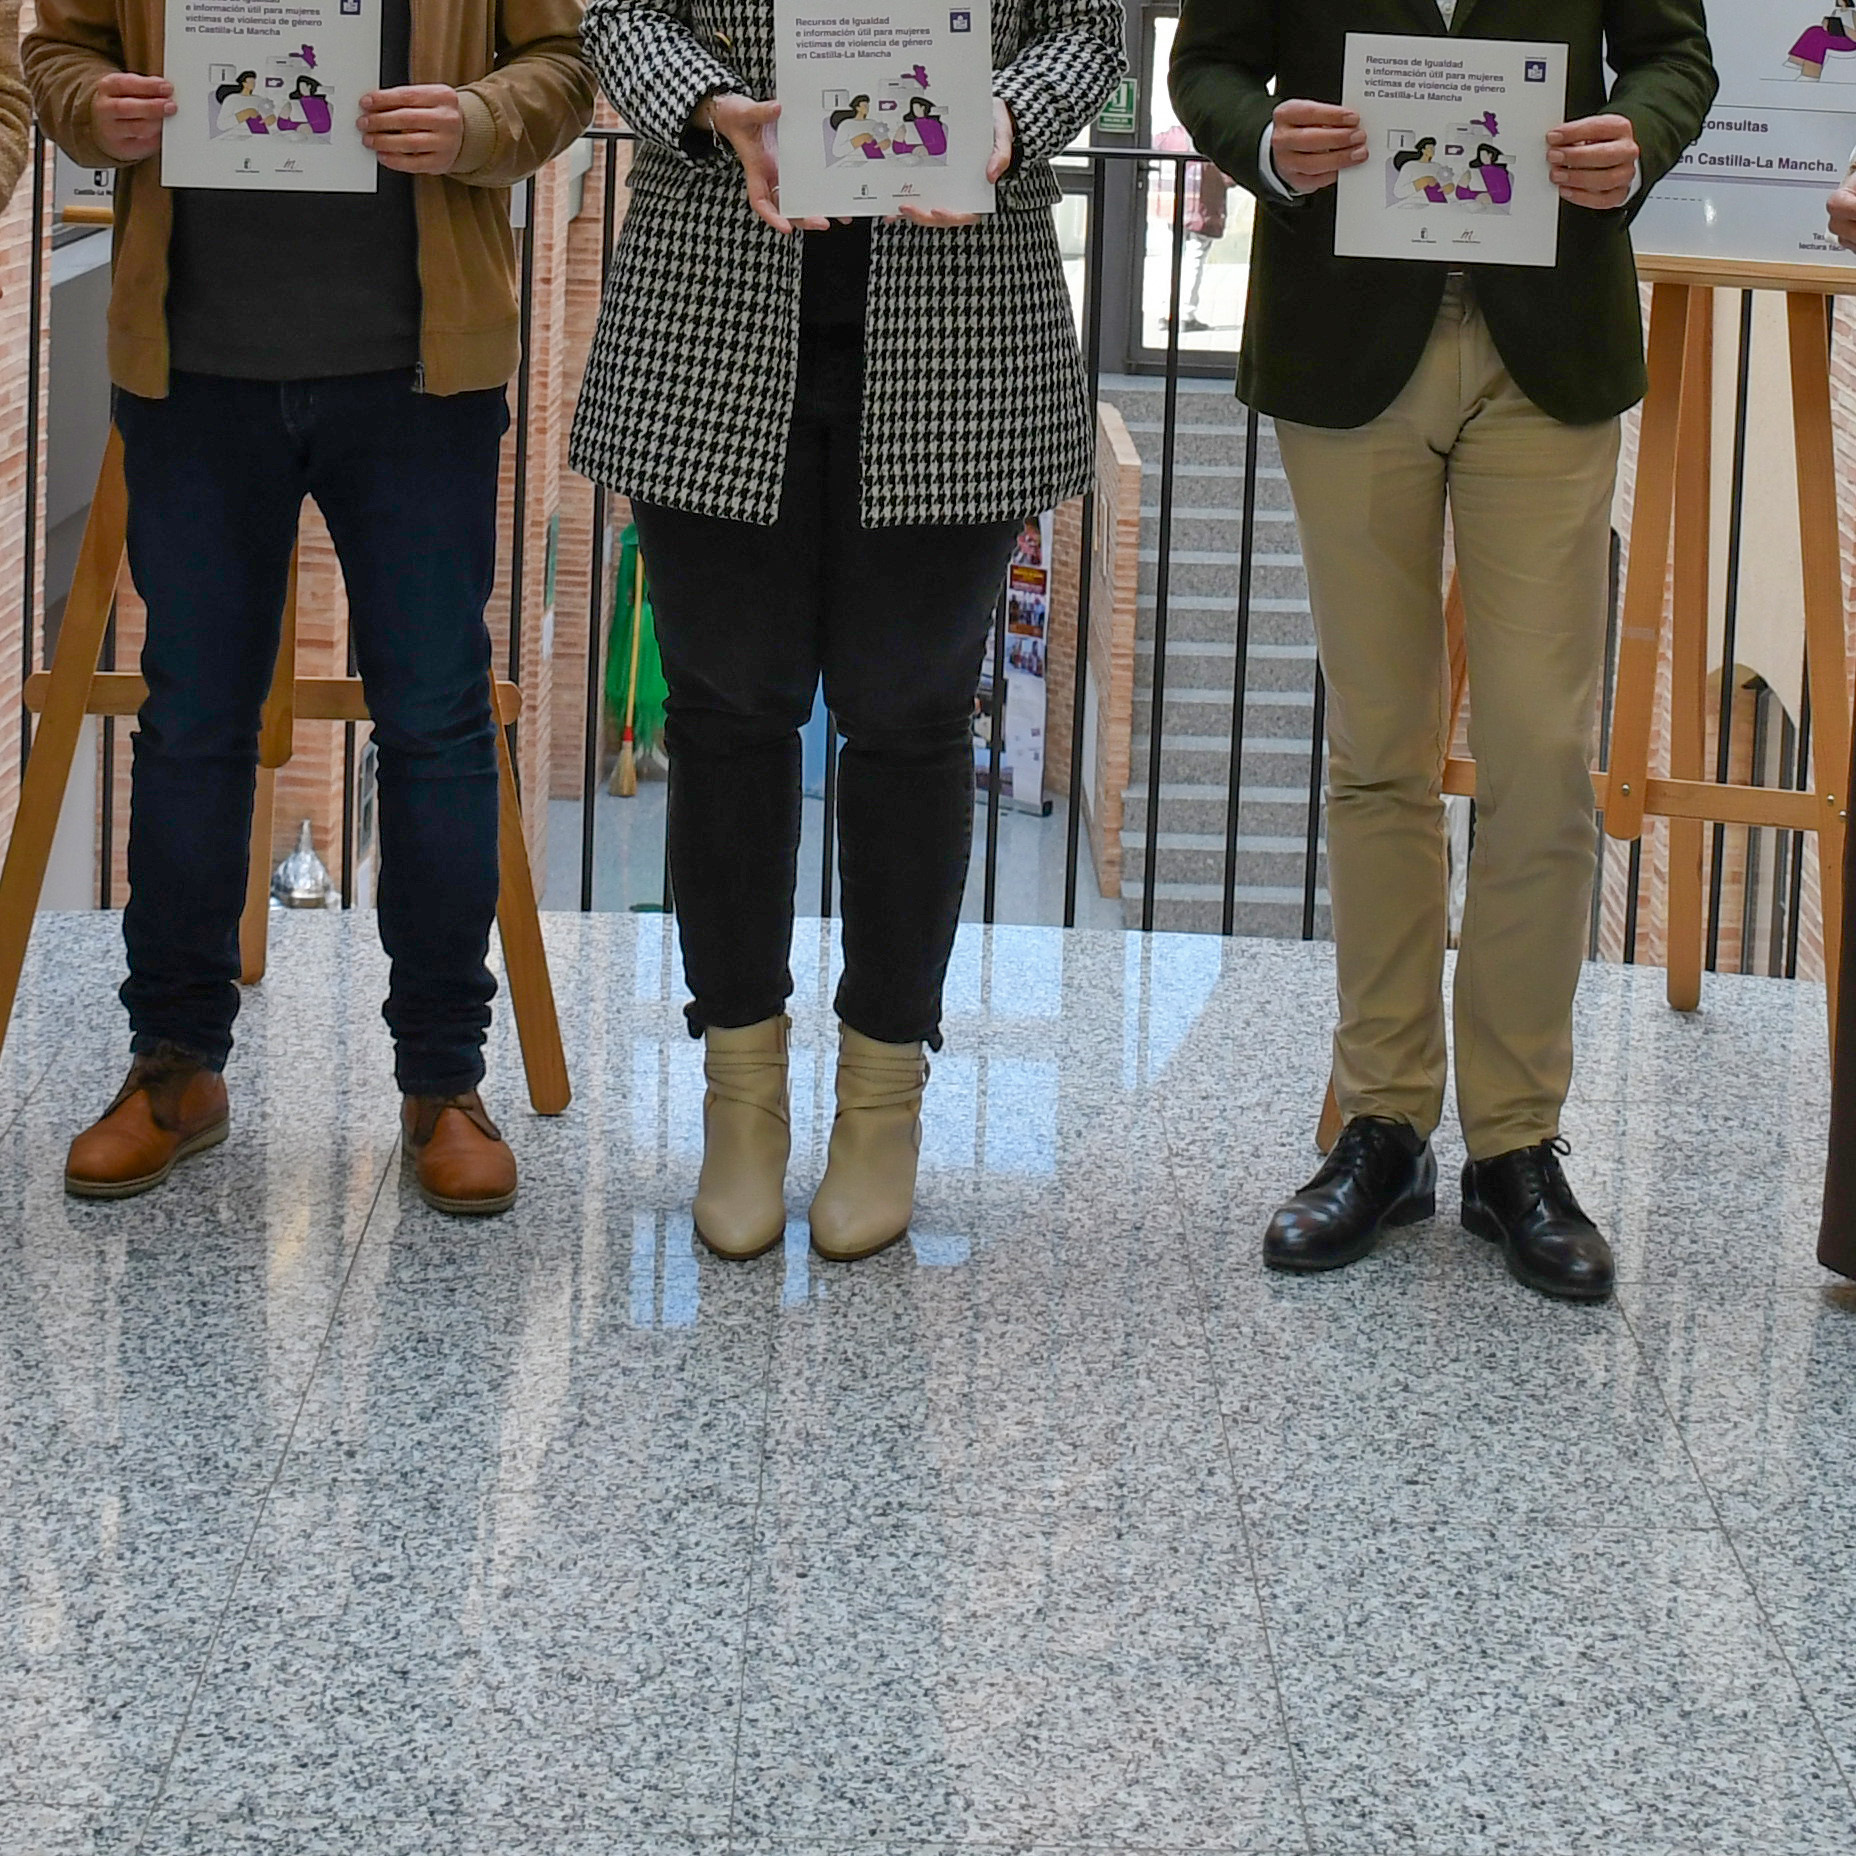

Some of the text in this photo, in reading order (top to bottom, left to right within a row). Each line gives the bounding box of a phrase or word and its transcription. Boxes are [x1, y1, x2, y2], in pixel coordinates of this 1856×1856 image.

[795, 16, 890, 27] Recursos de Igualdad
[803, 28, 856, 38] información
[857, 27, 872, 36] útil
[873, 29, 893, 38] para
[895, 28, 931, 37] mujeres
[795, 38, 933, 49] víctimas de violencia de género
[809, 50, 856, 60] Castilla-La
[857, 50, 892, 58] Mancha
[1366, 55, 1464, 69] Recursos de Igualdad
[1372, 67, 1427, 78] información
[1428, 70, 1444, 79] útil
[1445, 72, 1466, 81] para
[1467, 73, 1504, 83] mujeres
[1364, 78, 1506, 94] víctimas de violencia de género
[1363, 89, 1463, 102] en Castilla-La Mancha
[1701, 117, 1769, 133] consultas
[1697, 152, 1774, 169] Castilla-La
[1777, 157, 1838, 173] Mancha.
